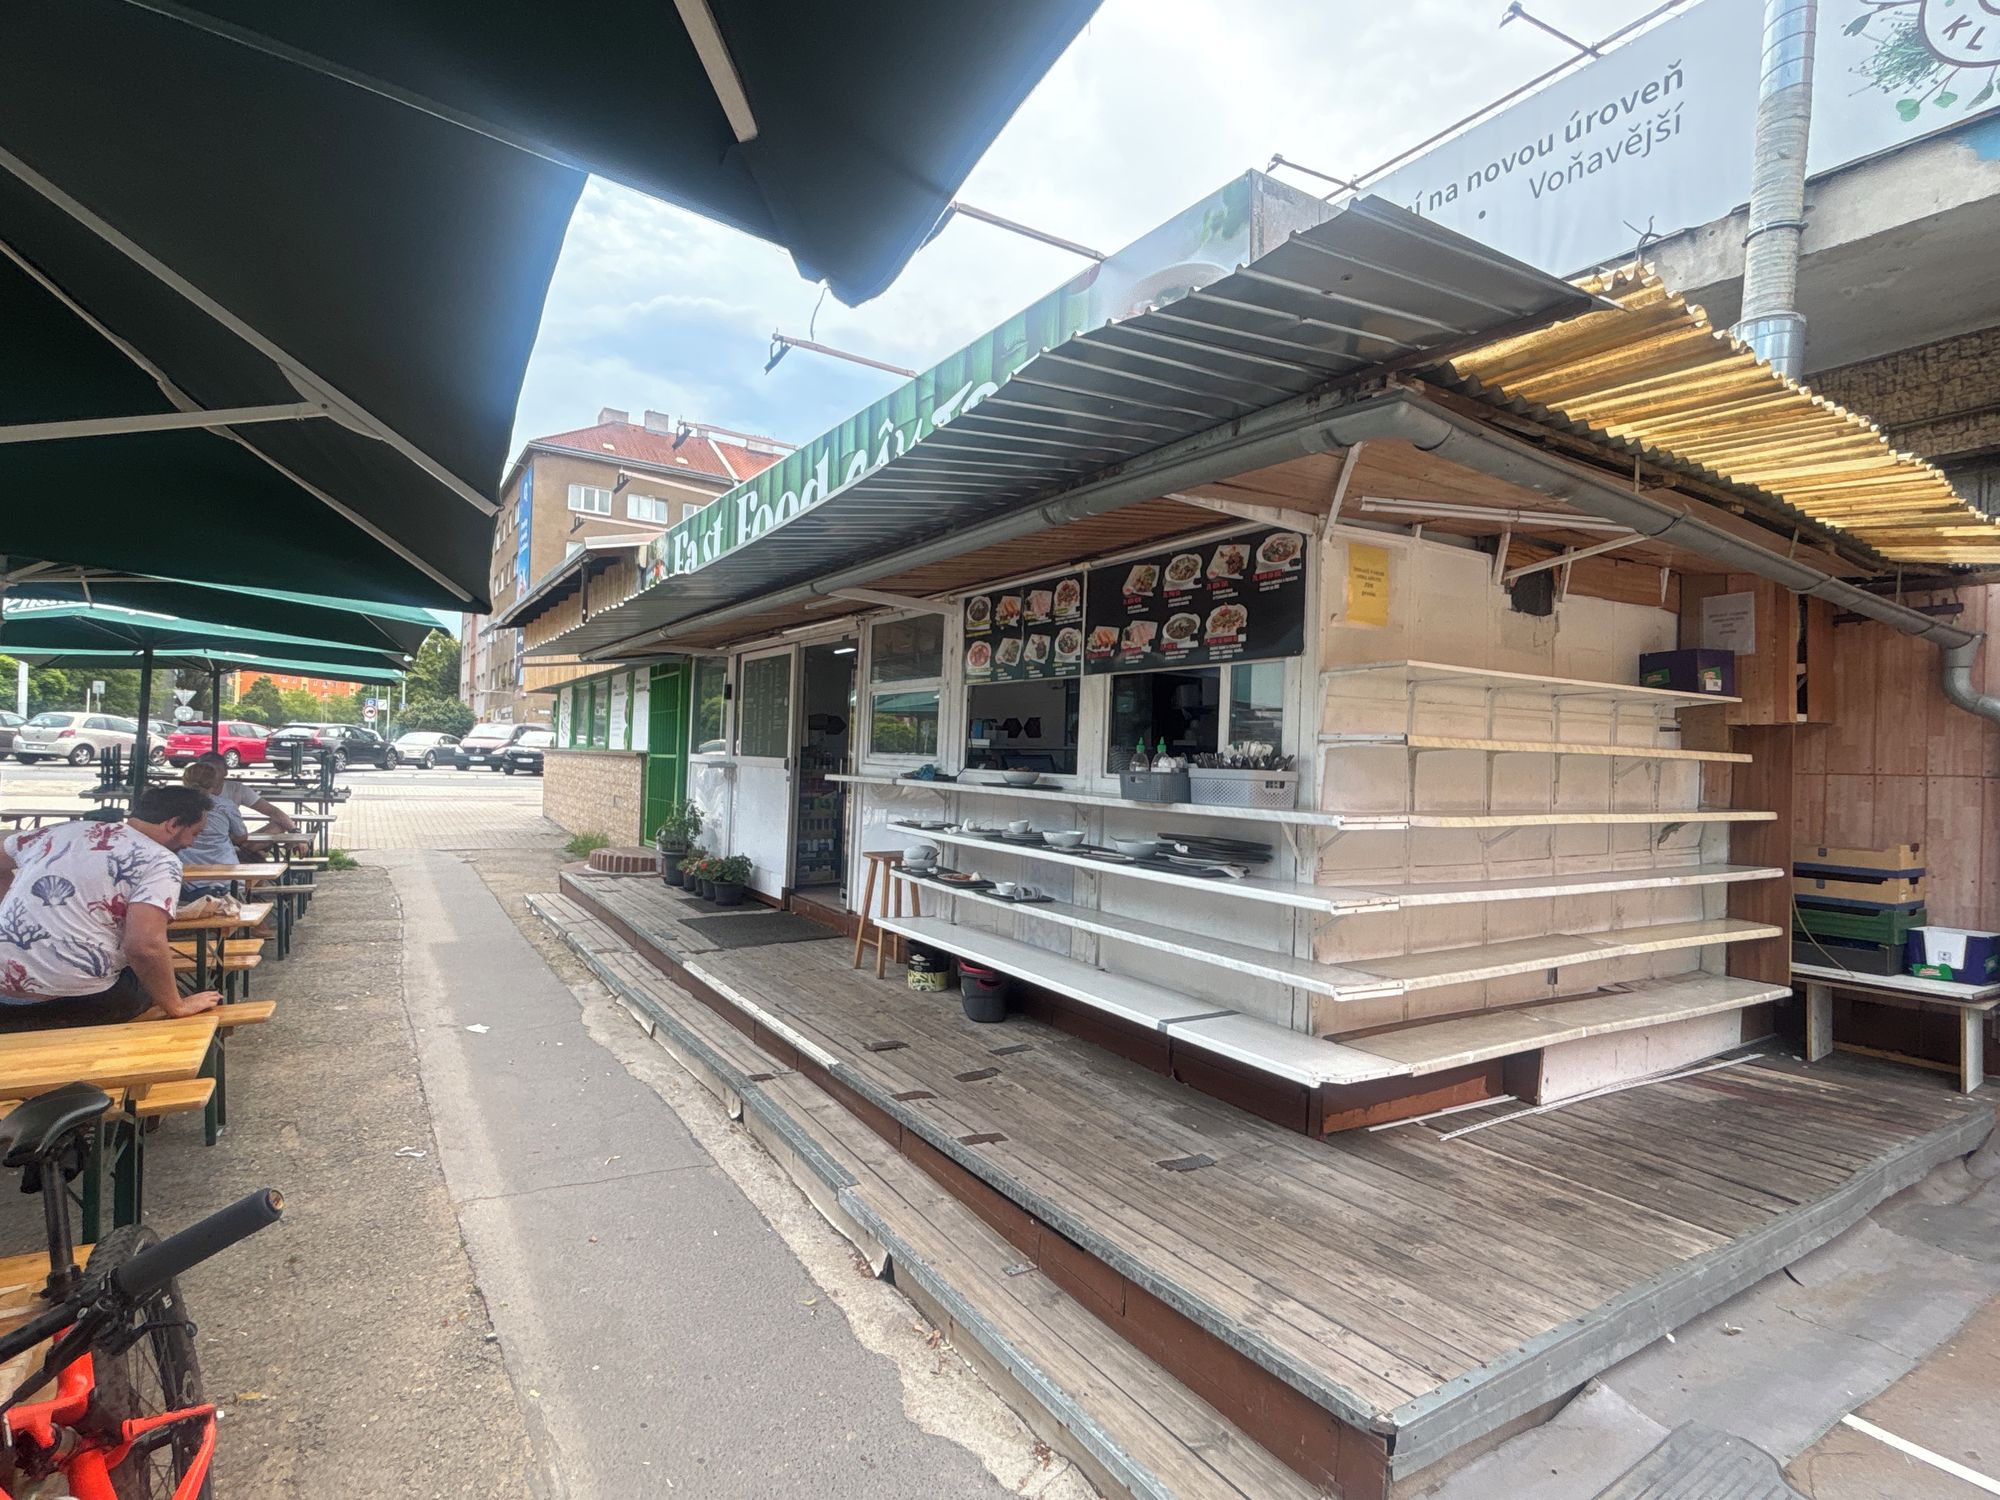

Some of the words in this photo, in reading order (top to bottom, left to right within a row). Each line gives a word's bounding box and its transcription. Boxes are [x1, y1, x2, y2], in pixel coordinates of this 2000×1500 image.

[1429, 183, 1458, 211] na
[1467, 133, 1553, 192] novou
[1564, 58, 1684, 143] úroveň
[1529, 101, 1685, 199] Voňavější
[673, 510, 723, 574] Fast
[737, 447, 829, 545] Food
